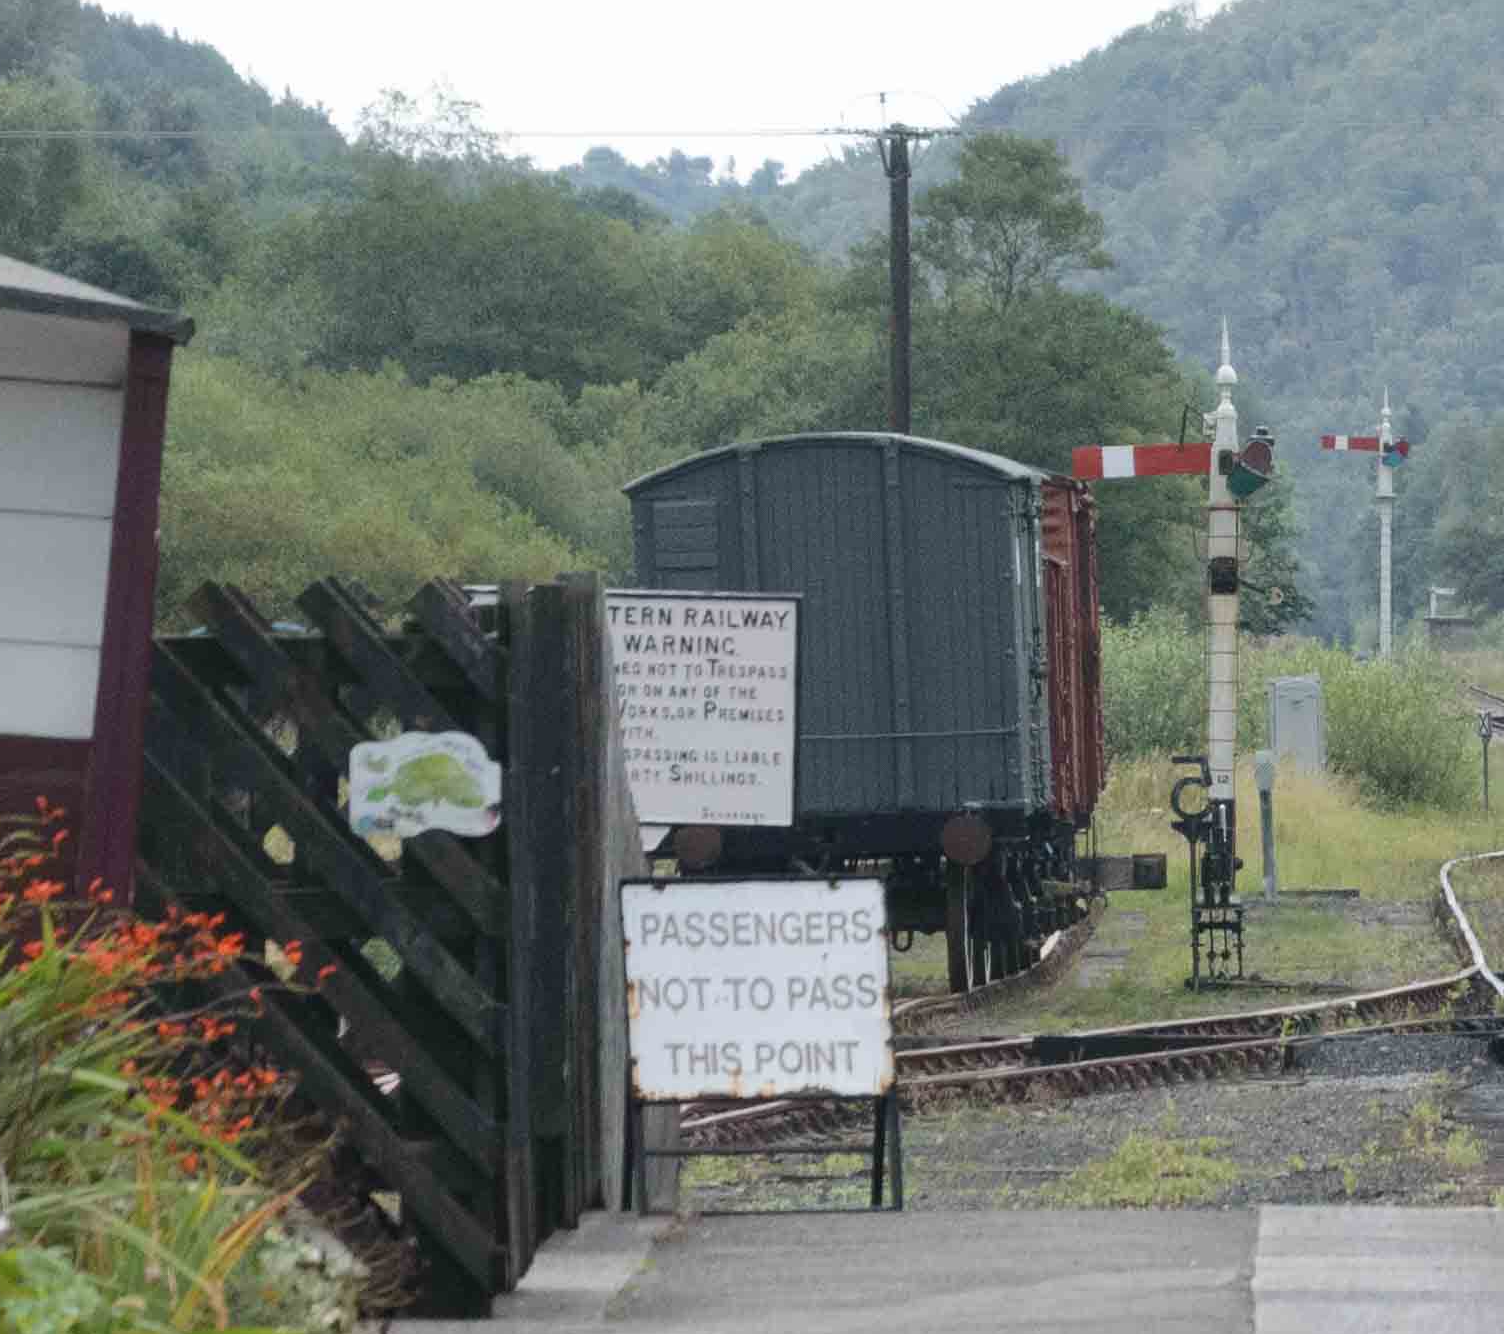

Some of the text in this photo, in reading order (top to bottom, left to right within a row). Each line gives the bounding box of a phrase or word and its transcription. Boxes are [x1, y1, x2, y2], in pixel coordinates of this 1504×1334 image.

[684, 608, 790, 630] RAILWAY
[647, 663, 677, 677] NOT
[685, 664, 703, 680] TO
[706, 659, 787, 679] TRESPASS
[643, 685, 663, 698] ON
[669, 686, 697, 699] ANY
[703, 686, 721, 700] OF
[728, 687, 758, 700] THE
[703, 701, 785, 722] PREMISES
[725, 752, 783, 766] LIABLE
[641, 910, 873, 948] PASSENGERS
[640, 974, 878, 1011] NOT TO PASS
[664, 1040, 859, 1077] THIS POINT
